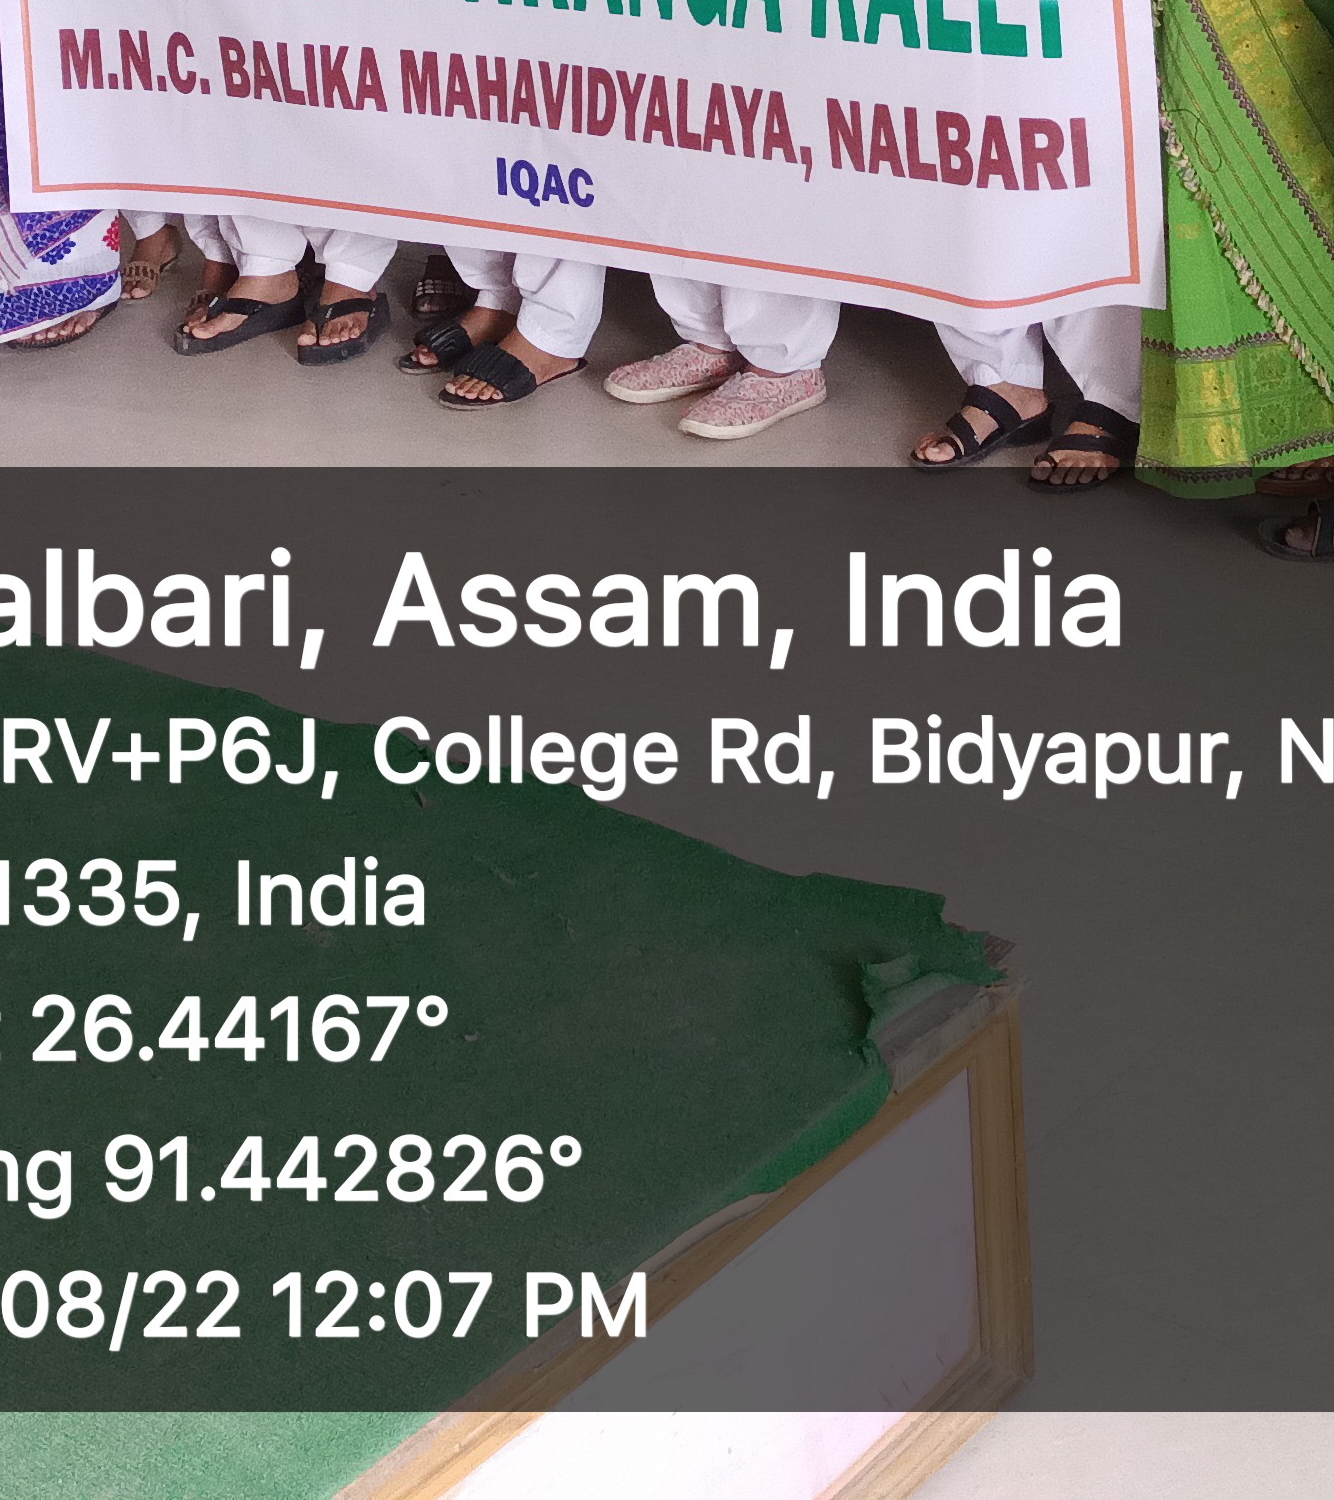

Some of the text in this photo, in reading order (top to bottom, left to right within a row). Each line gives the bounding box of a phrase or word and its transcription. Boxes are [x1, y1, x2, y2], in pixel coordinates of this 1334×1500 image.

[59, 28, 1092, 192] M.N.C. BALIKA MAHAVIDYALAYA, NALBARI
[496, 157, 595, 208] IQAC
